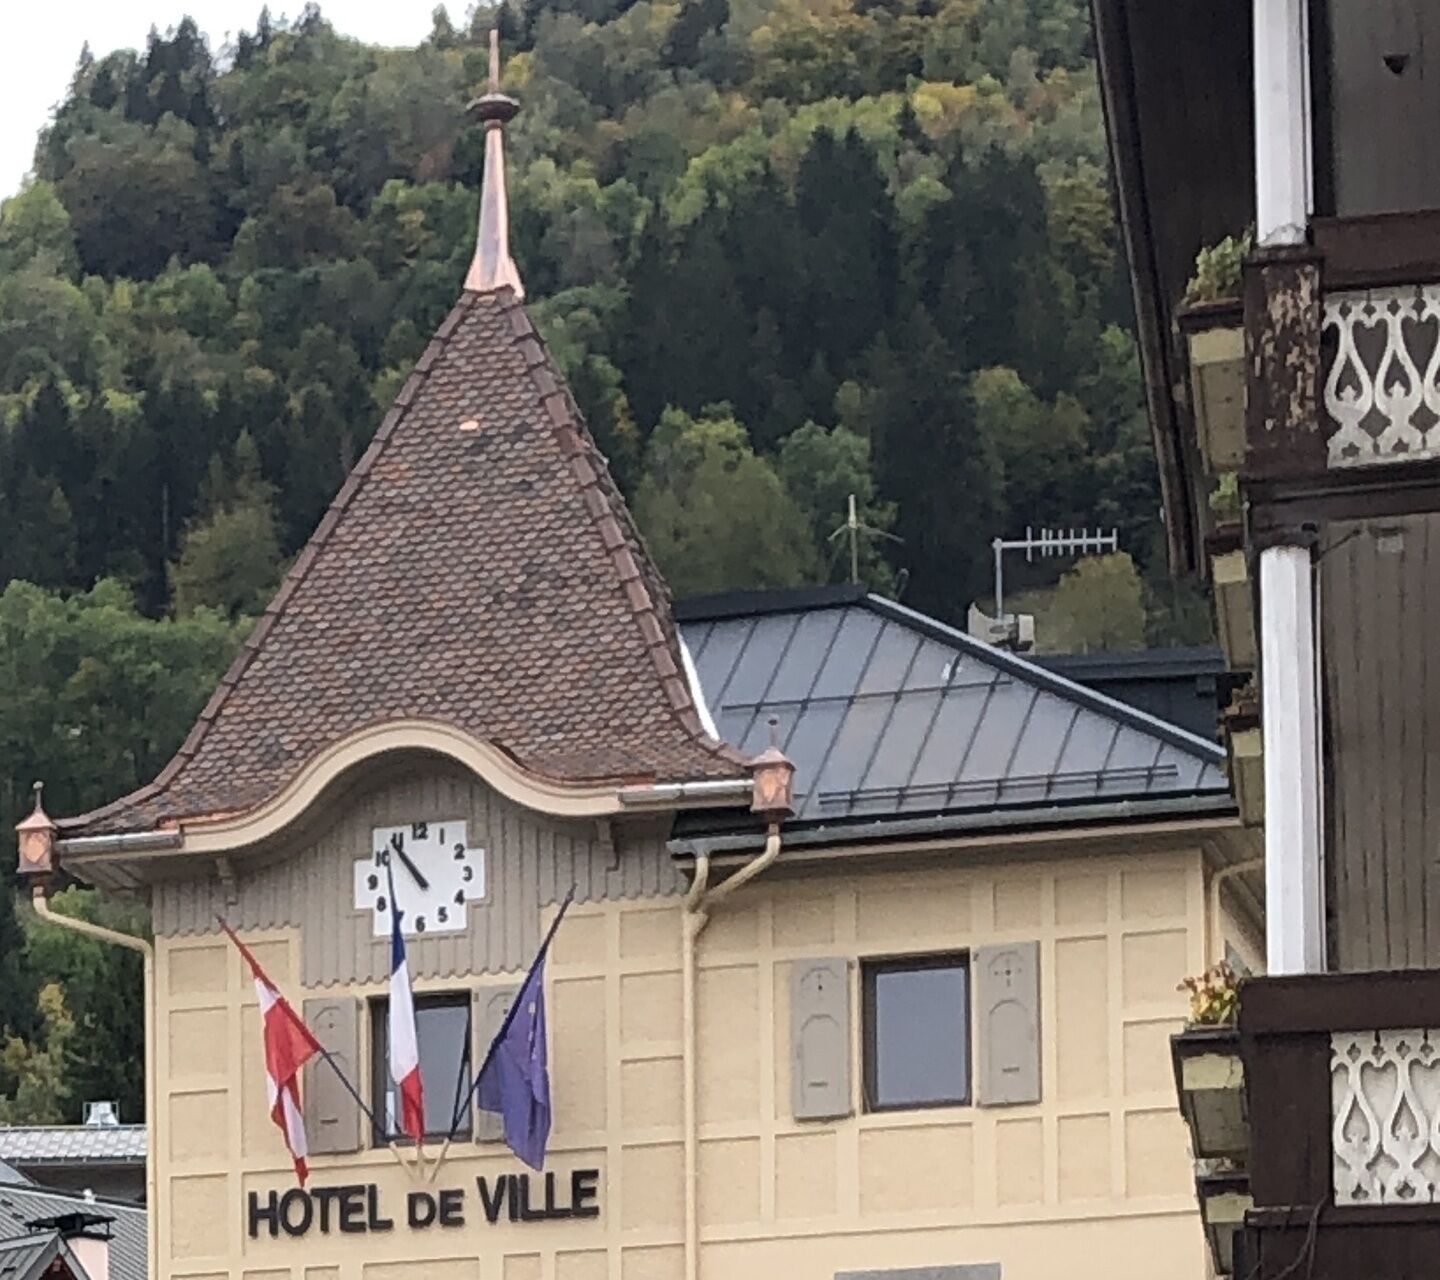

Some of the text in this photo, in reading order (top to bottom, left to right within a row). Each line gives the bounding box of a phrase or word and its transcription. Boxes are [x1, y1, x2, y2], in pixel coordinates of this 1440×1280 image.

[412, 822, 428, 840] 12
[440, 828, 445, 845] 1
[454, 843, 465, 860] 2
[368, 874, 378, 890] 9
[463, 866, 473, 882] 3
[377, 896, 386, 912] 8
[454, 889, 465, 905] 4
[438, 906, 448, 923] 5
[415, 916, 426, 932] 6
[407, 1189, 465, 1228] DE
[476, 1169, 600, 1224] VILLE
